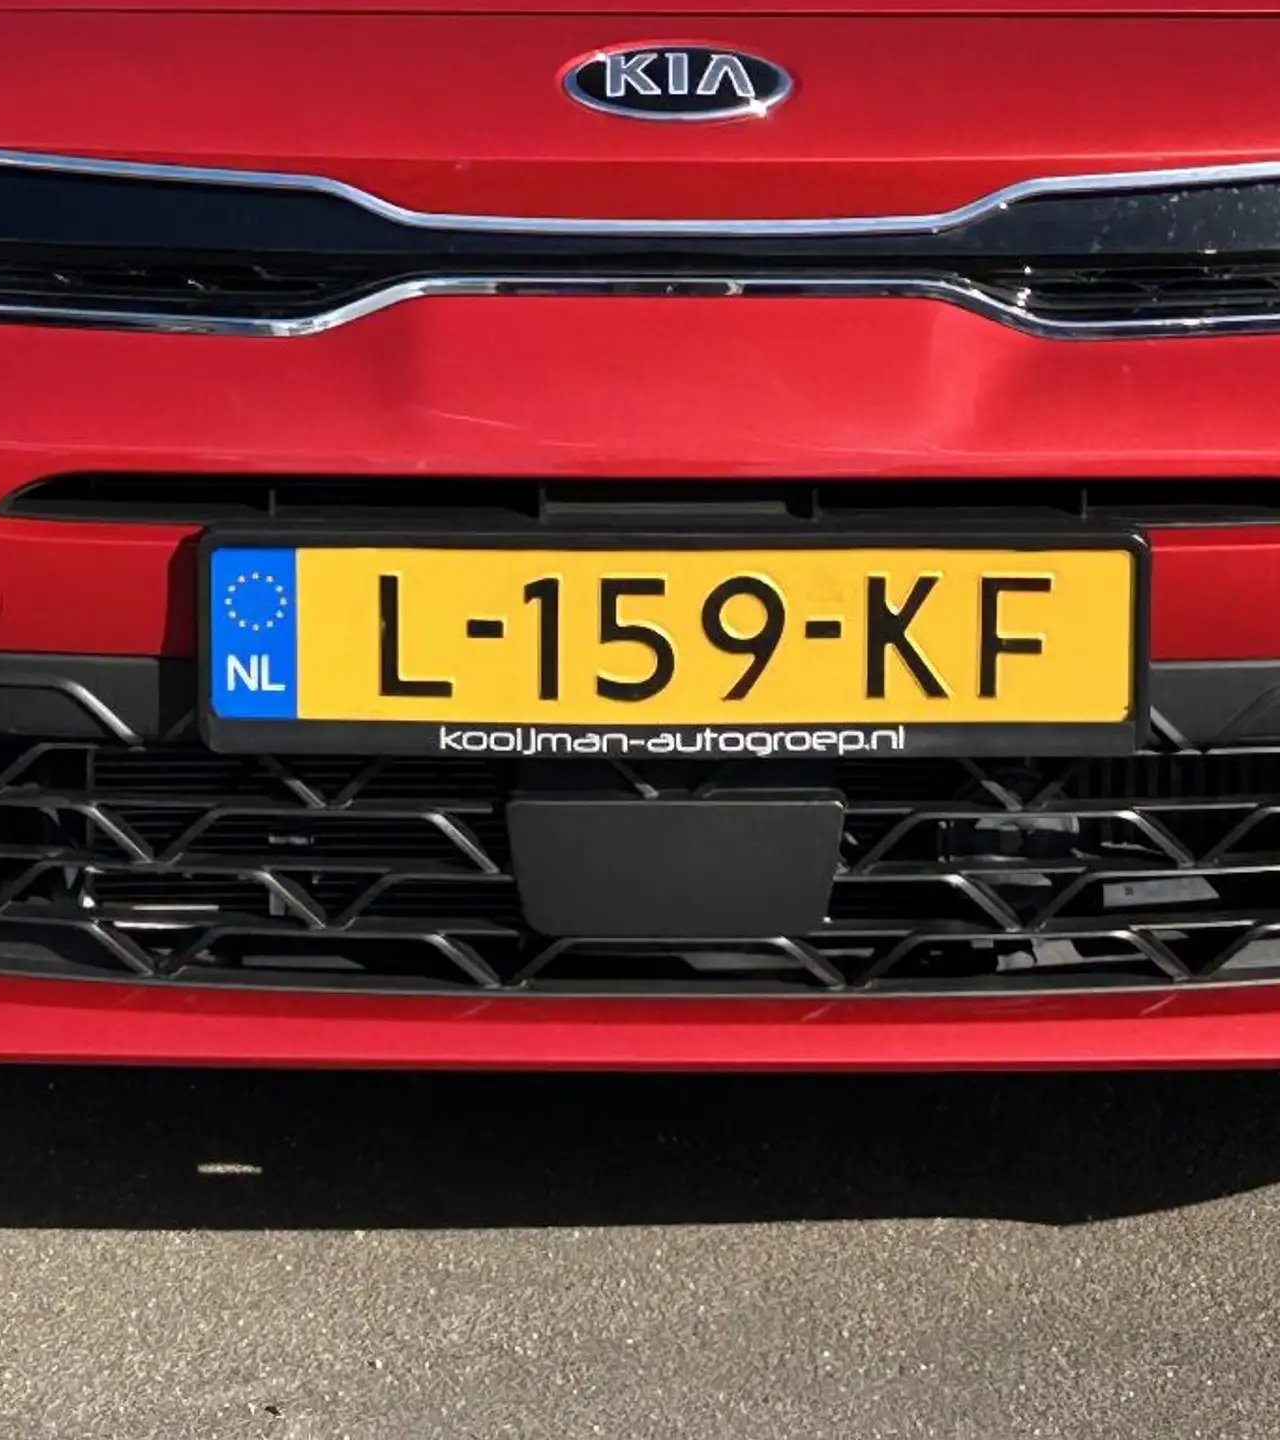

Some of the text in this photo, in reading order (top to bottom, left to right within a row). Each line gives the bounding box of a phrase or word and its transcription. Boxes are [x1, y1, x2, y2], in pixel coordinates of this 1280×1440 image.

[605, 52, 756, 98] KIA
[379, 575, 1053, 702] L-159-KF
[227, 654, 286, 692] NL
